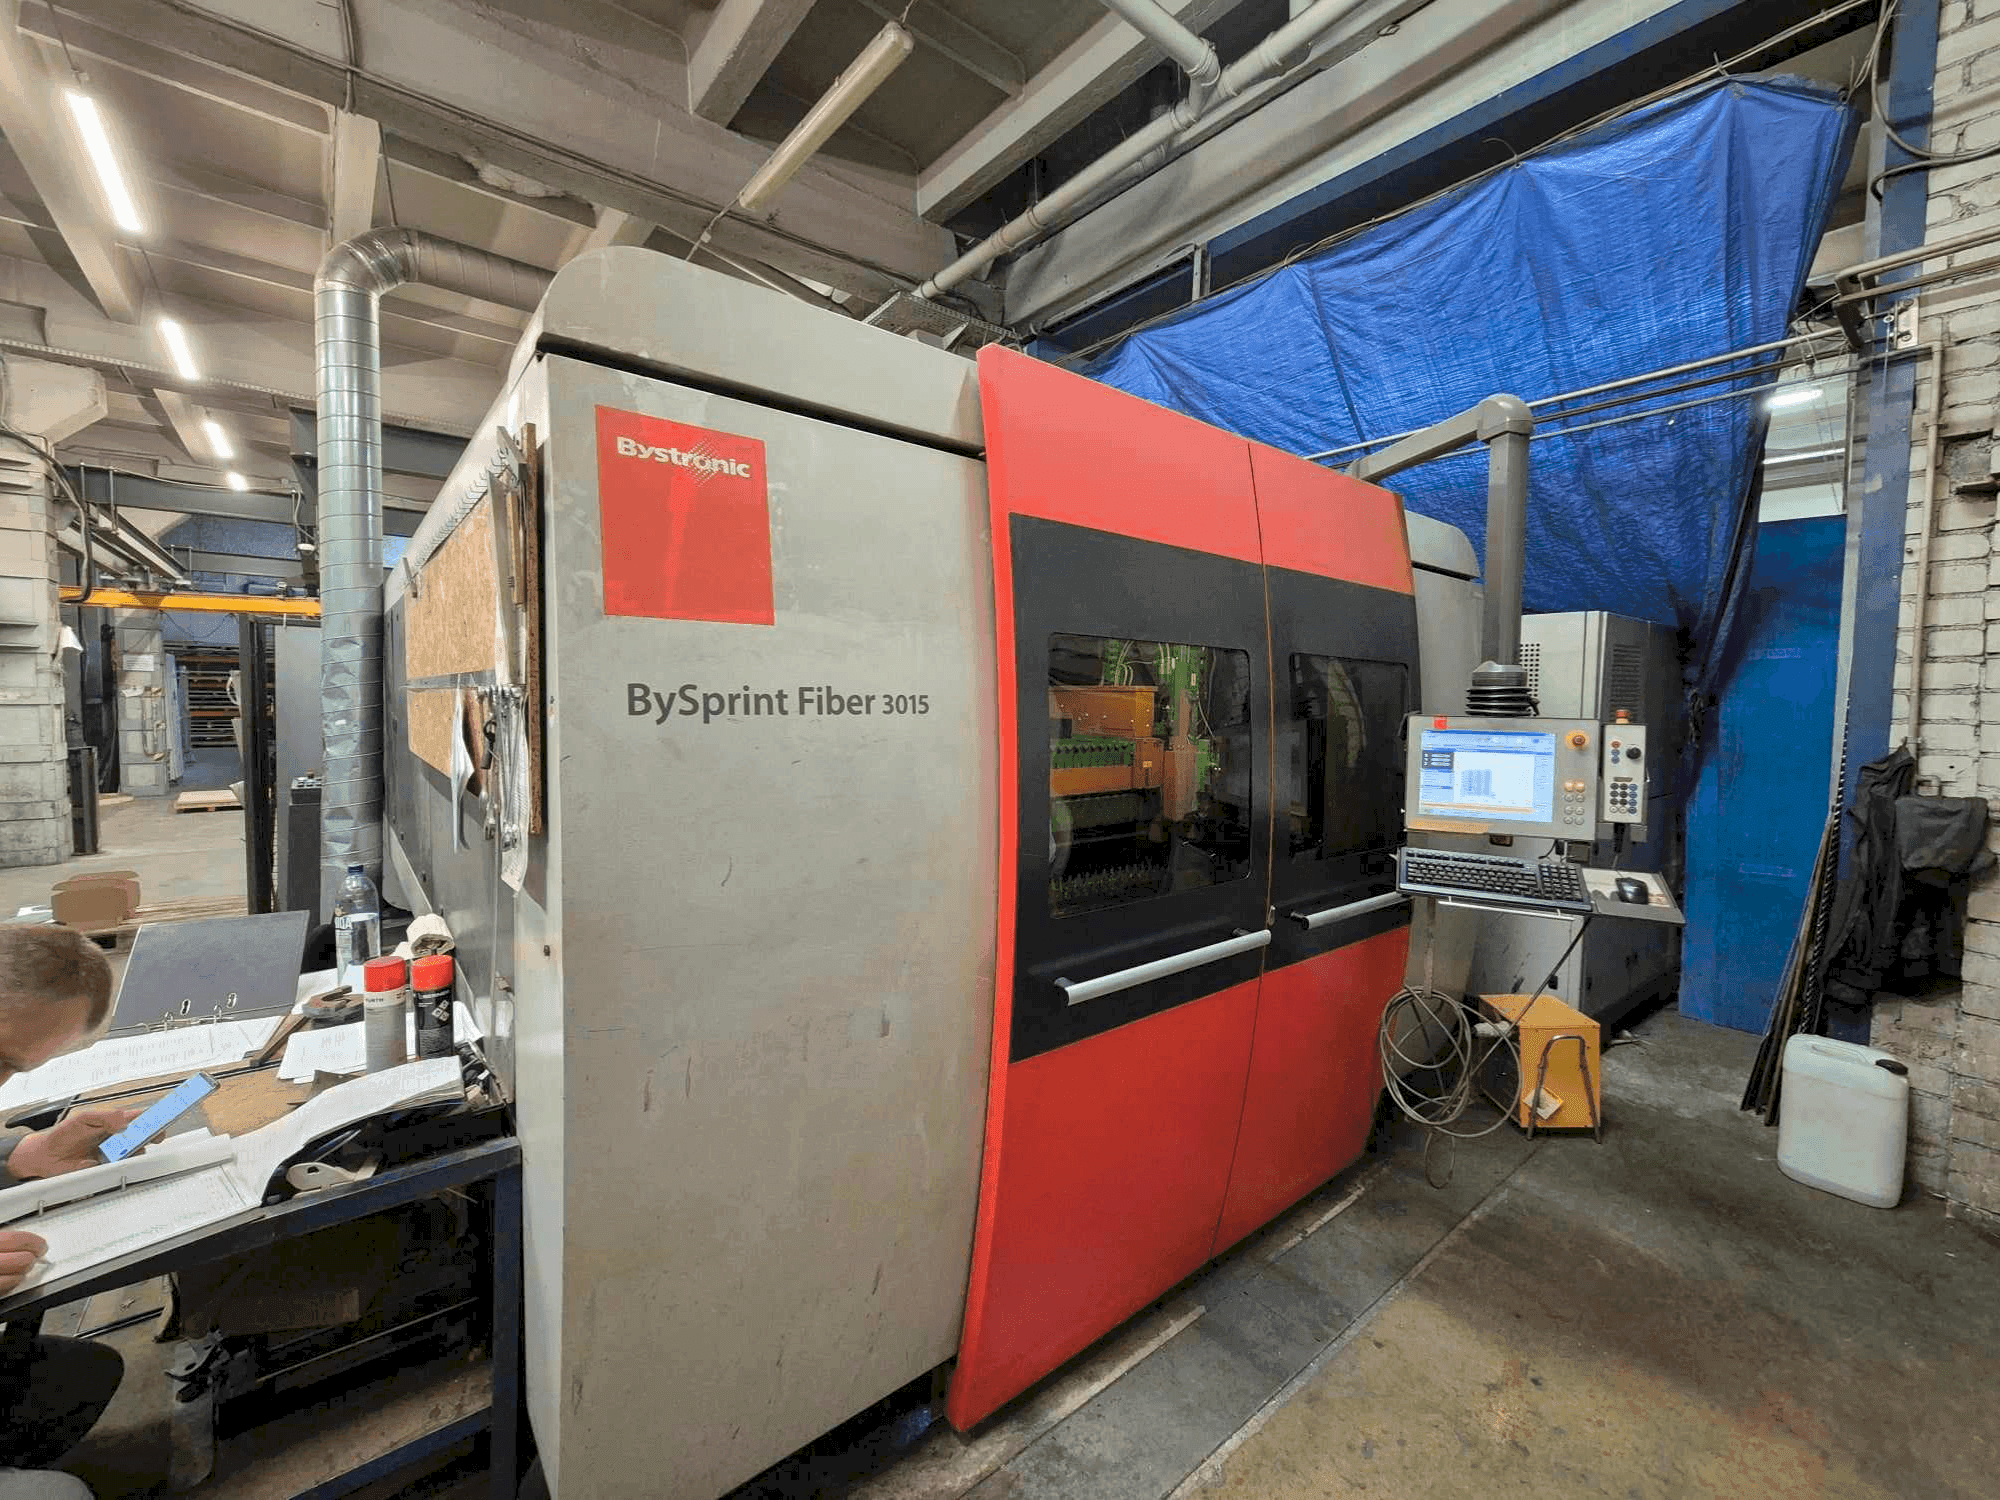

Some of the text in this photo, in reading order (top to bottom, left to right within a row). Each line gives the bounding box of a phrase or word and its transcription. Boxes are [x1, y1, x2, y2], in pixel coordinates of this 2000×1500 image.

[617, 436, 750, 478] Bystronic
[627, 683, 930, 725] BySprint Fiber 3015
